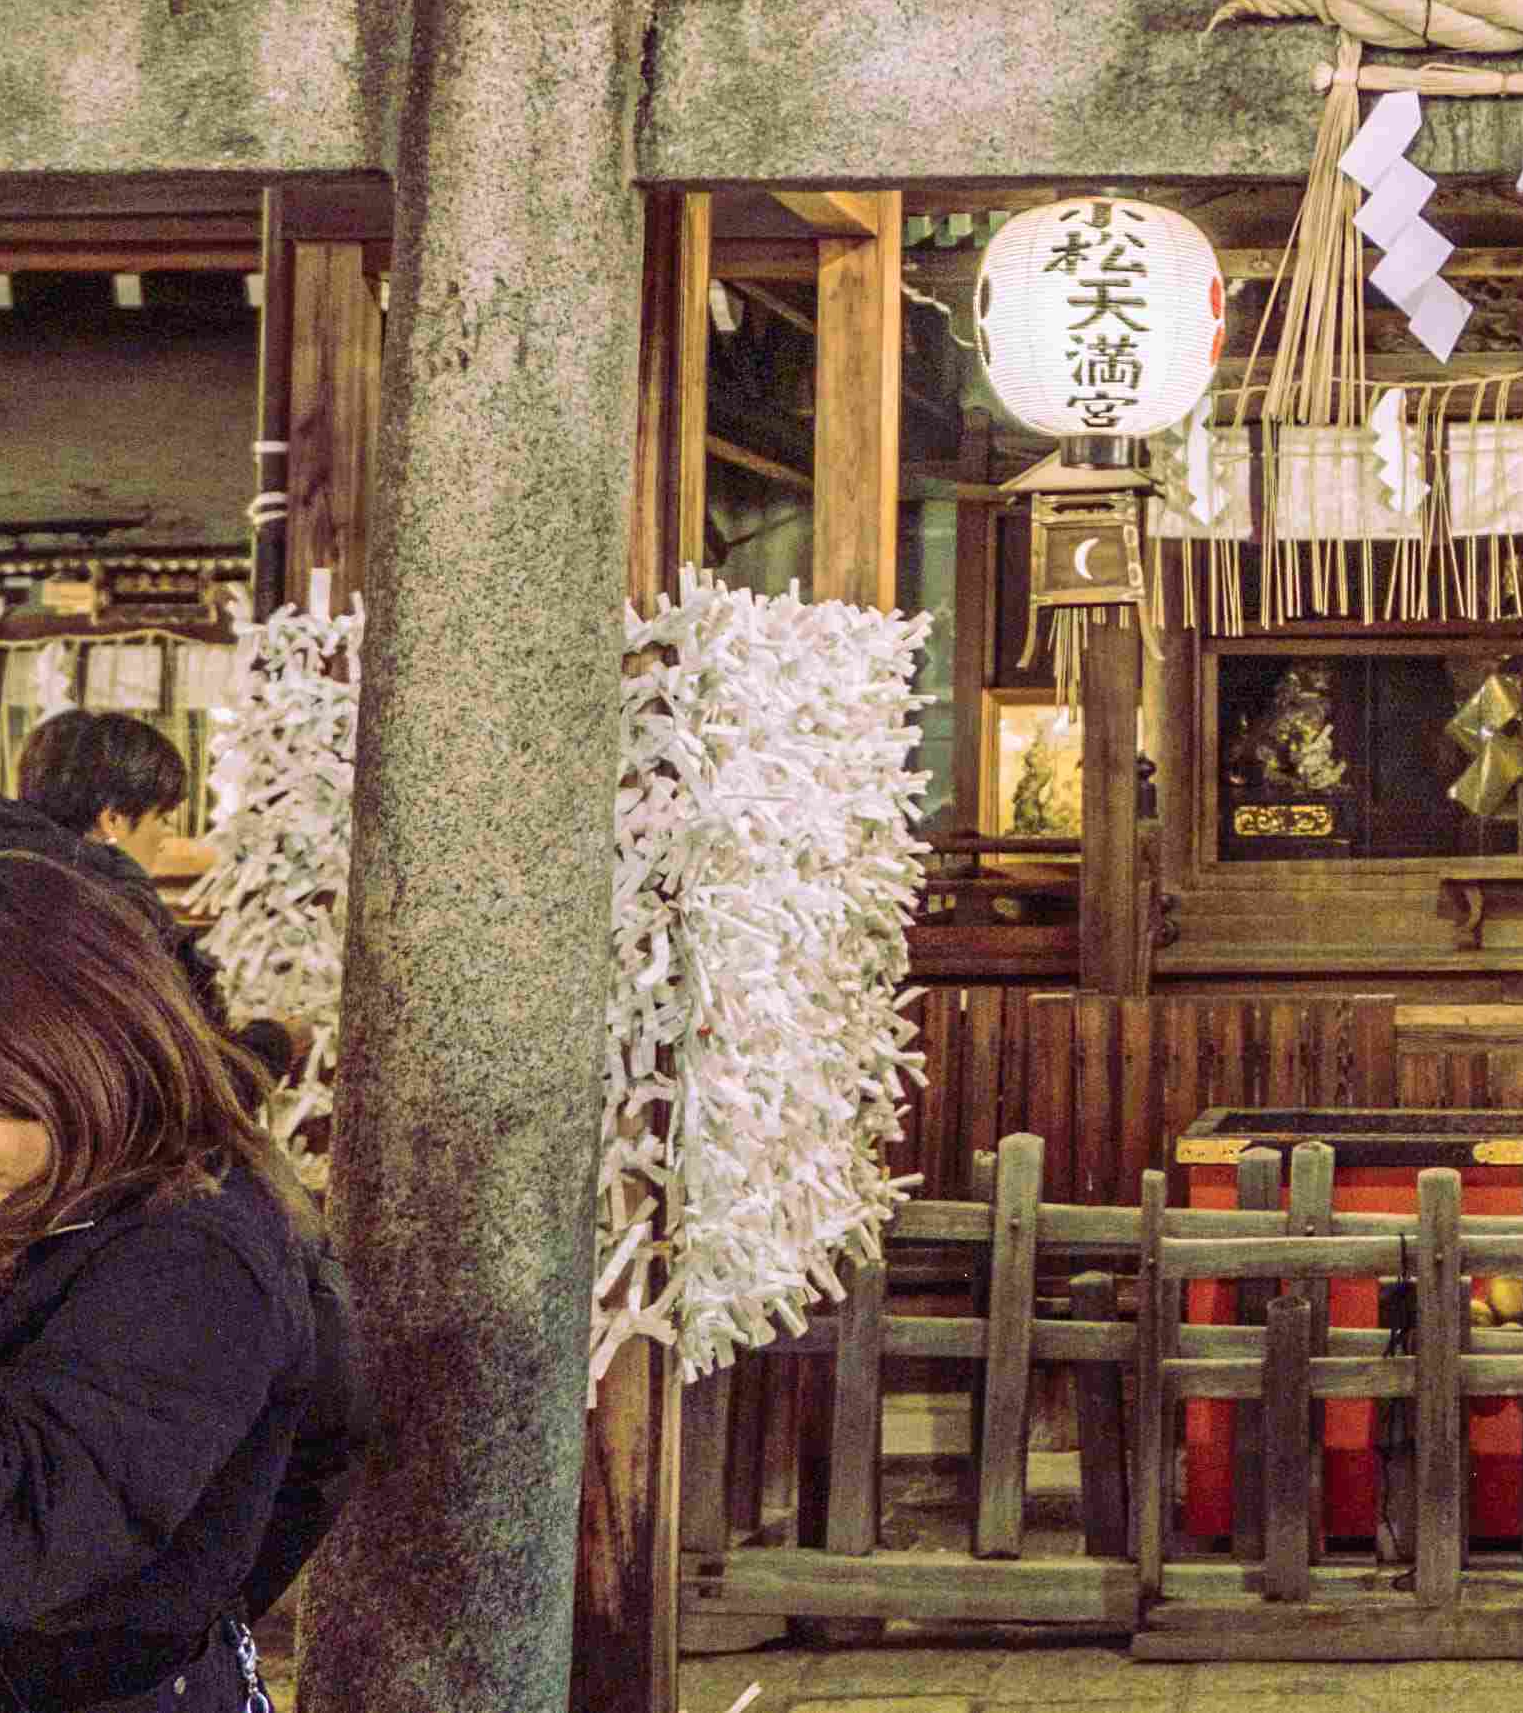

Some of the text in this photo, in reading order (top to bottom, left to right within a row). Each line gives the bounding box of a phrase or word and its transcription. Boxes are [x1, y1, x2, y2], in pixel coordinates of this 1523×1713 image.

[1042, 202, 1151, 429] 小松天満宮
